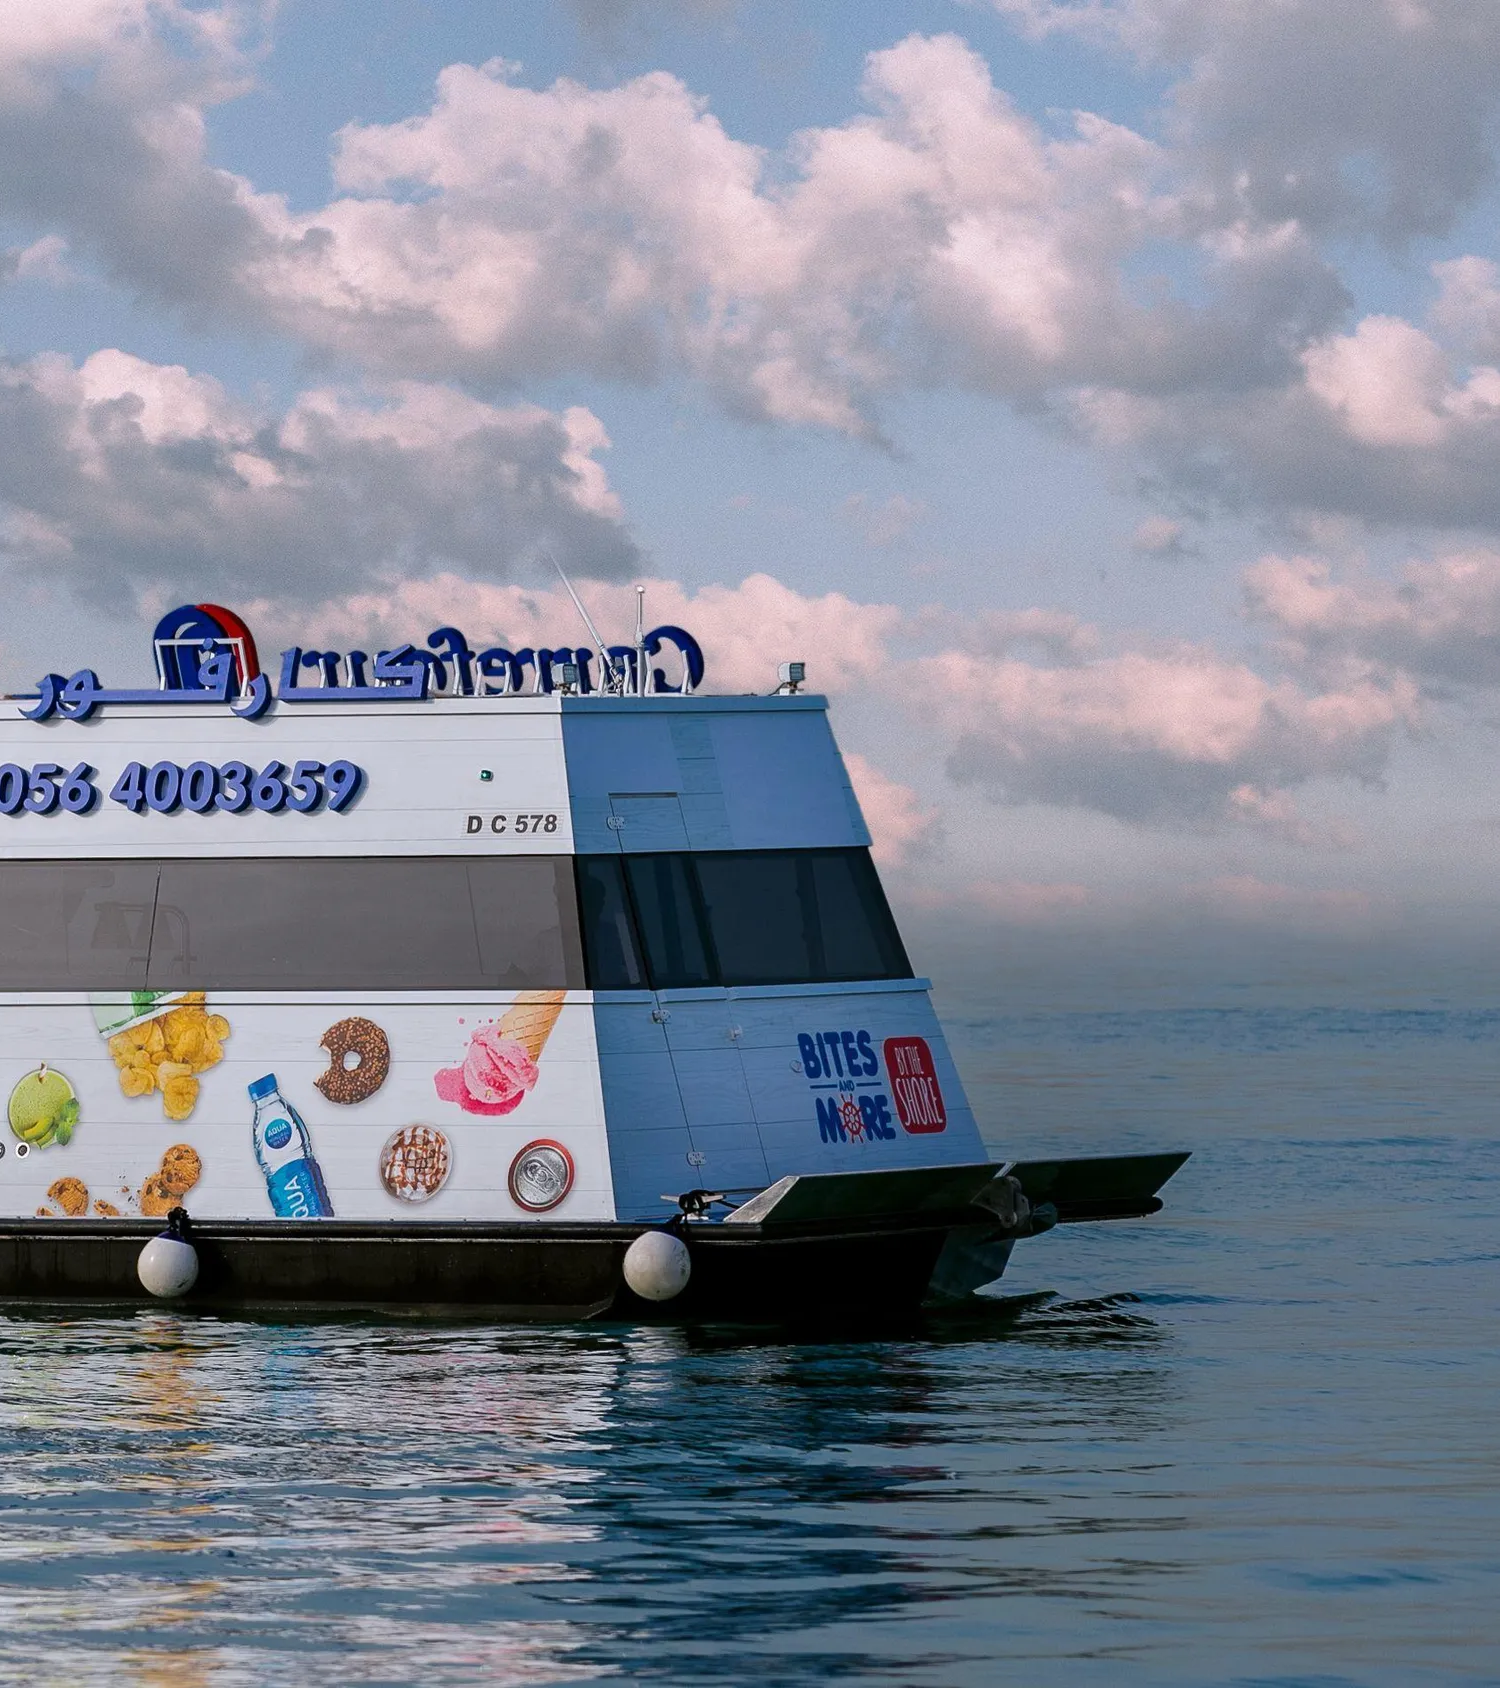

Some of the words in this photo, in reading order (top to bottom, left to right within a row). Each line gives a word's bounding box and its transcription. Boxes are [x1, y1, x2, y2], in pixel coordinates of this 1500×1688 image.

[110, 759, 365, 815] 4003659
[467, 815, 483, 834] D
[491, 814, 507, 834] C
[515, 814, 558, 833] 578
[797, 1029, 879, 1079] BITES
[894, 1046, 909, 1076] BY
[905, 1045, 924, 1075] THE
[838, 1079, 856, 1092] AND
[895, 1077, 944, 1127] SHORE
[267, 1123, 288, 1138] AQUA
[284, 1175, 310, 1217] QUA
